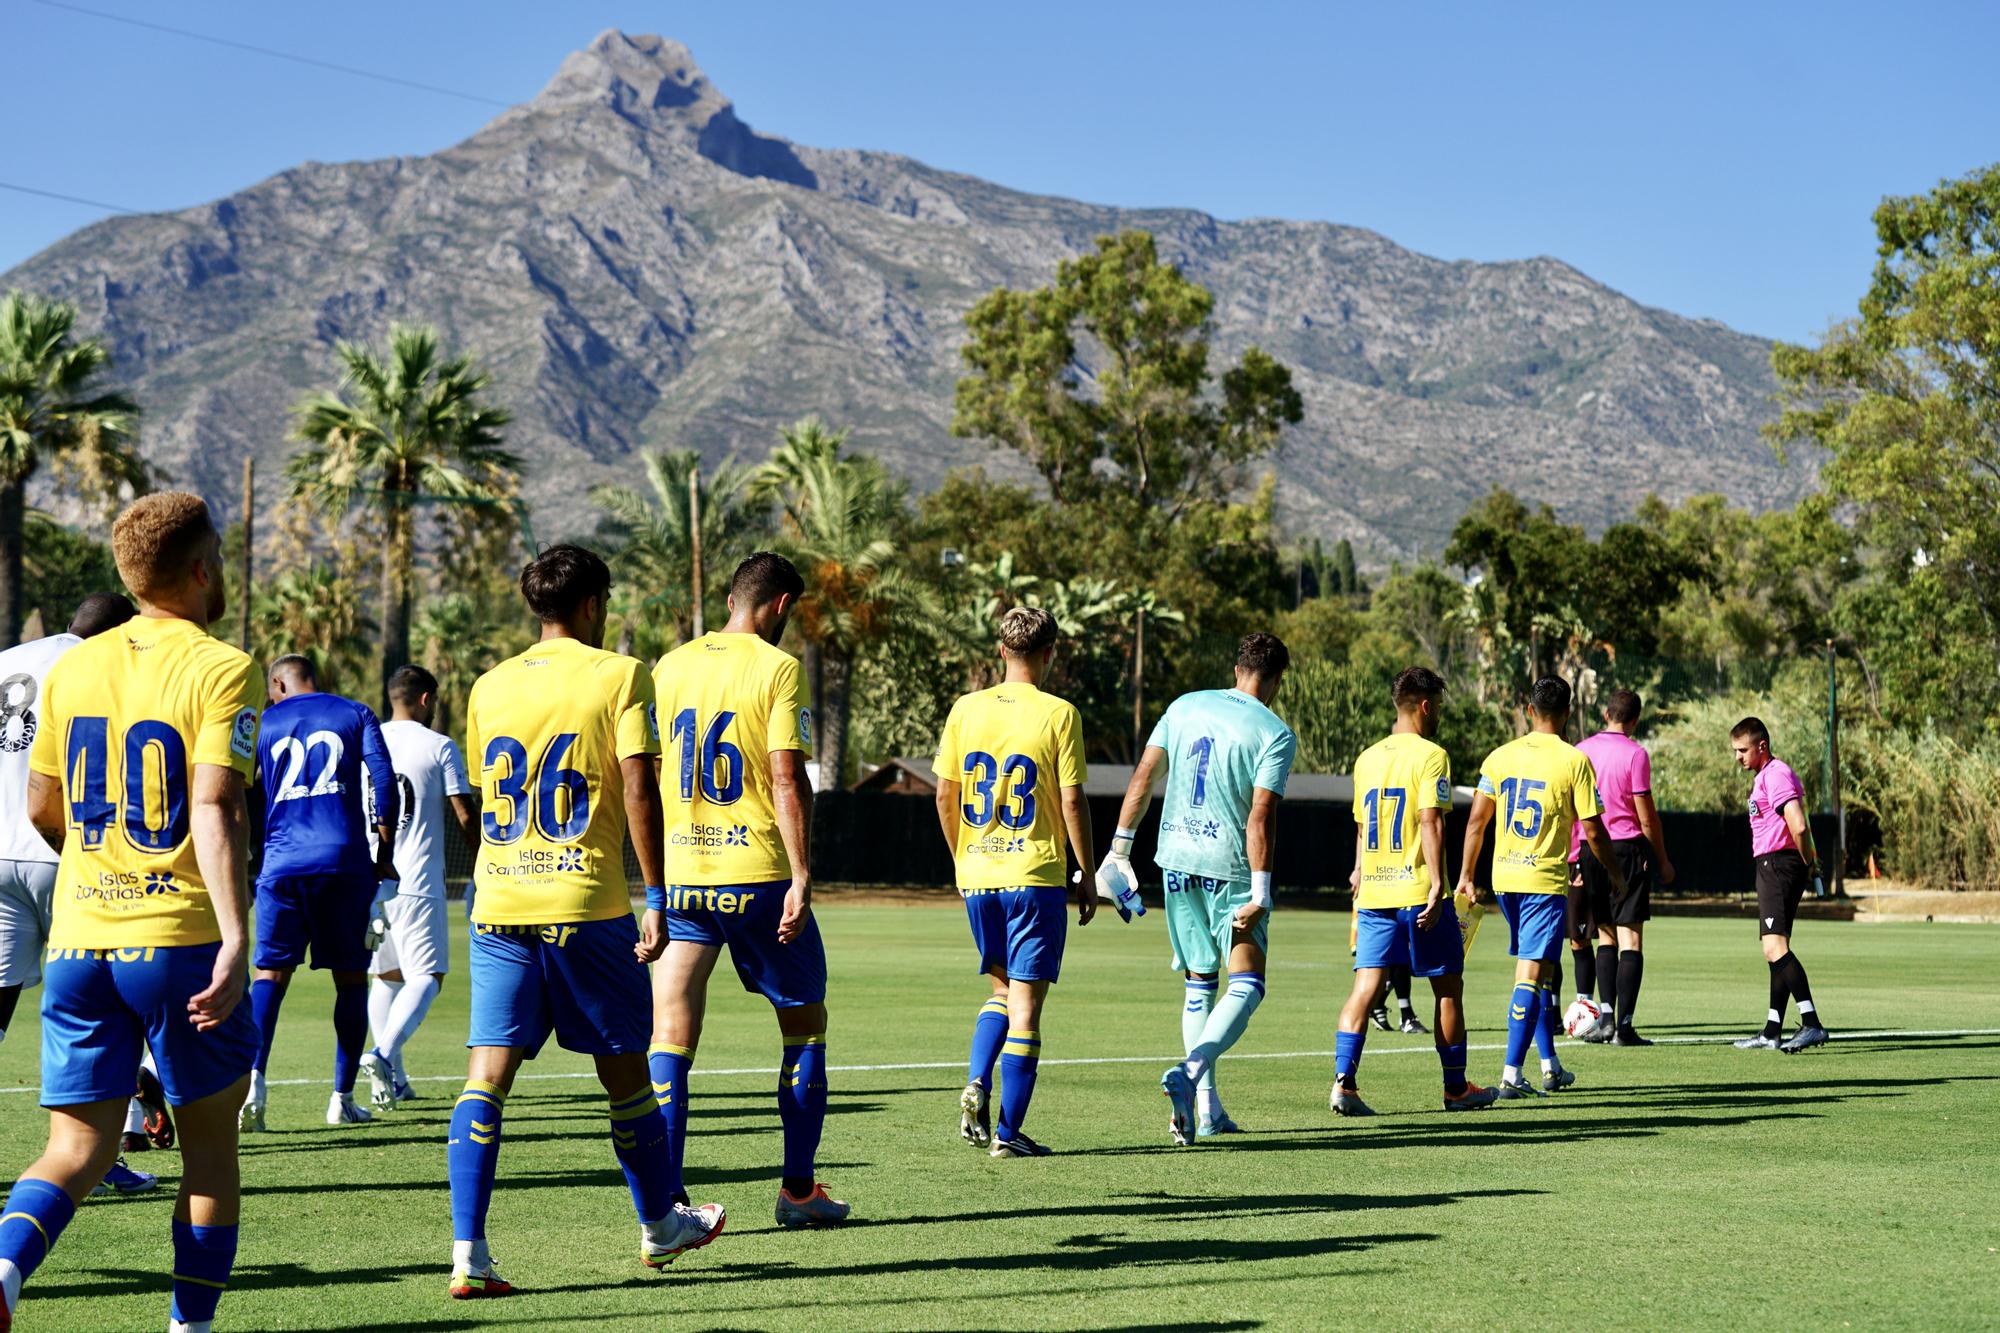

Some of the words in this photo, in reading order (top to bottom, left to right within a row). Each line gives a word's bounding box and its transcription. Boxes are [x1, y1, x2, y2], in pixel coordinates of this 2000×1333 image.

[233, 739, 253, 753] LaLig
[270, 730, 346, 804] 22
[670, 708, 745, 807] 16
[1186, 735, 1216, 810] 1
[65, 716, 191, 854] 40
[481, 733, 590, 847] 36
[960, 750, 1038, 831] 33
[1500, 776, 1547, 840] 15
[690, 822, 723, 835] Islas
[966, 844, 1006, 854] Caarias
[1363, 787, 1406, 853] 17
[100, 871, 139, 887] Islas
[487, 861, 554, 876] Canarias
[519, 848, 554, 862] Islas
